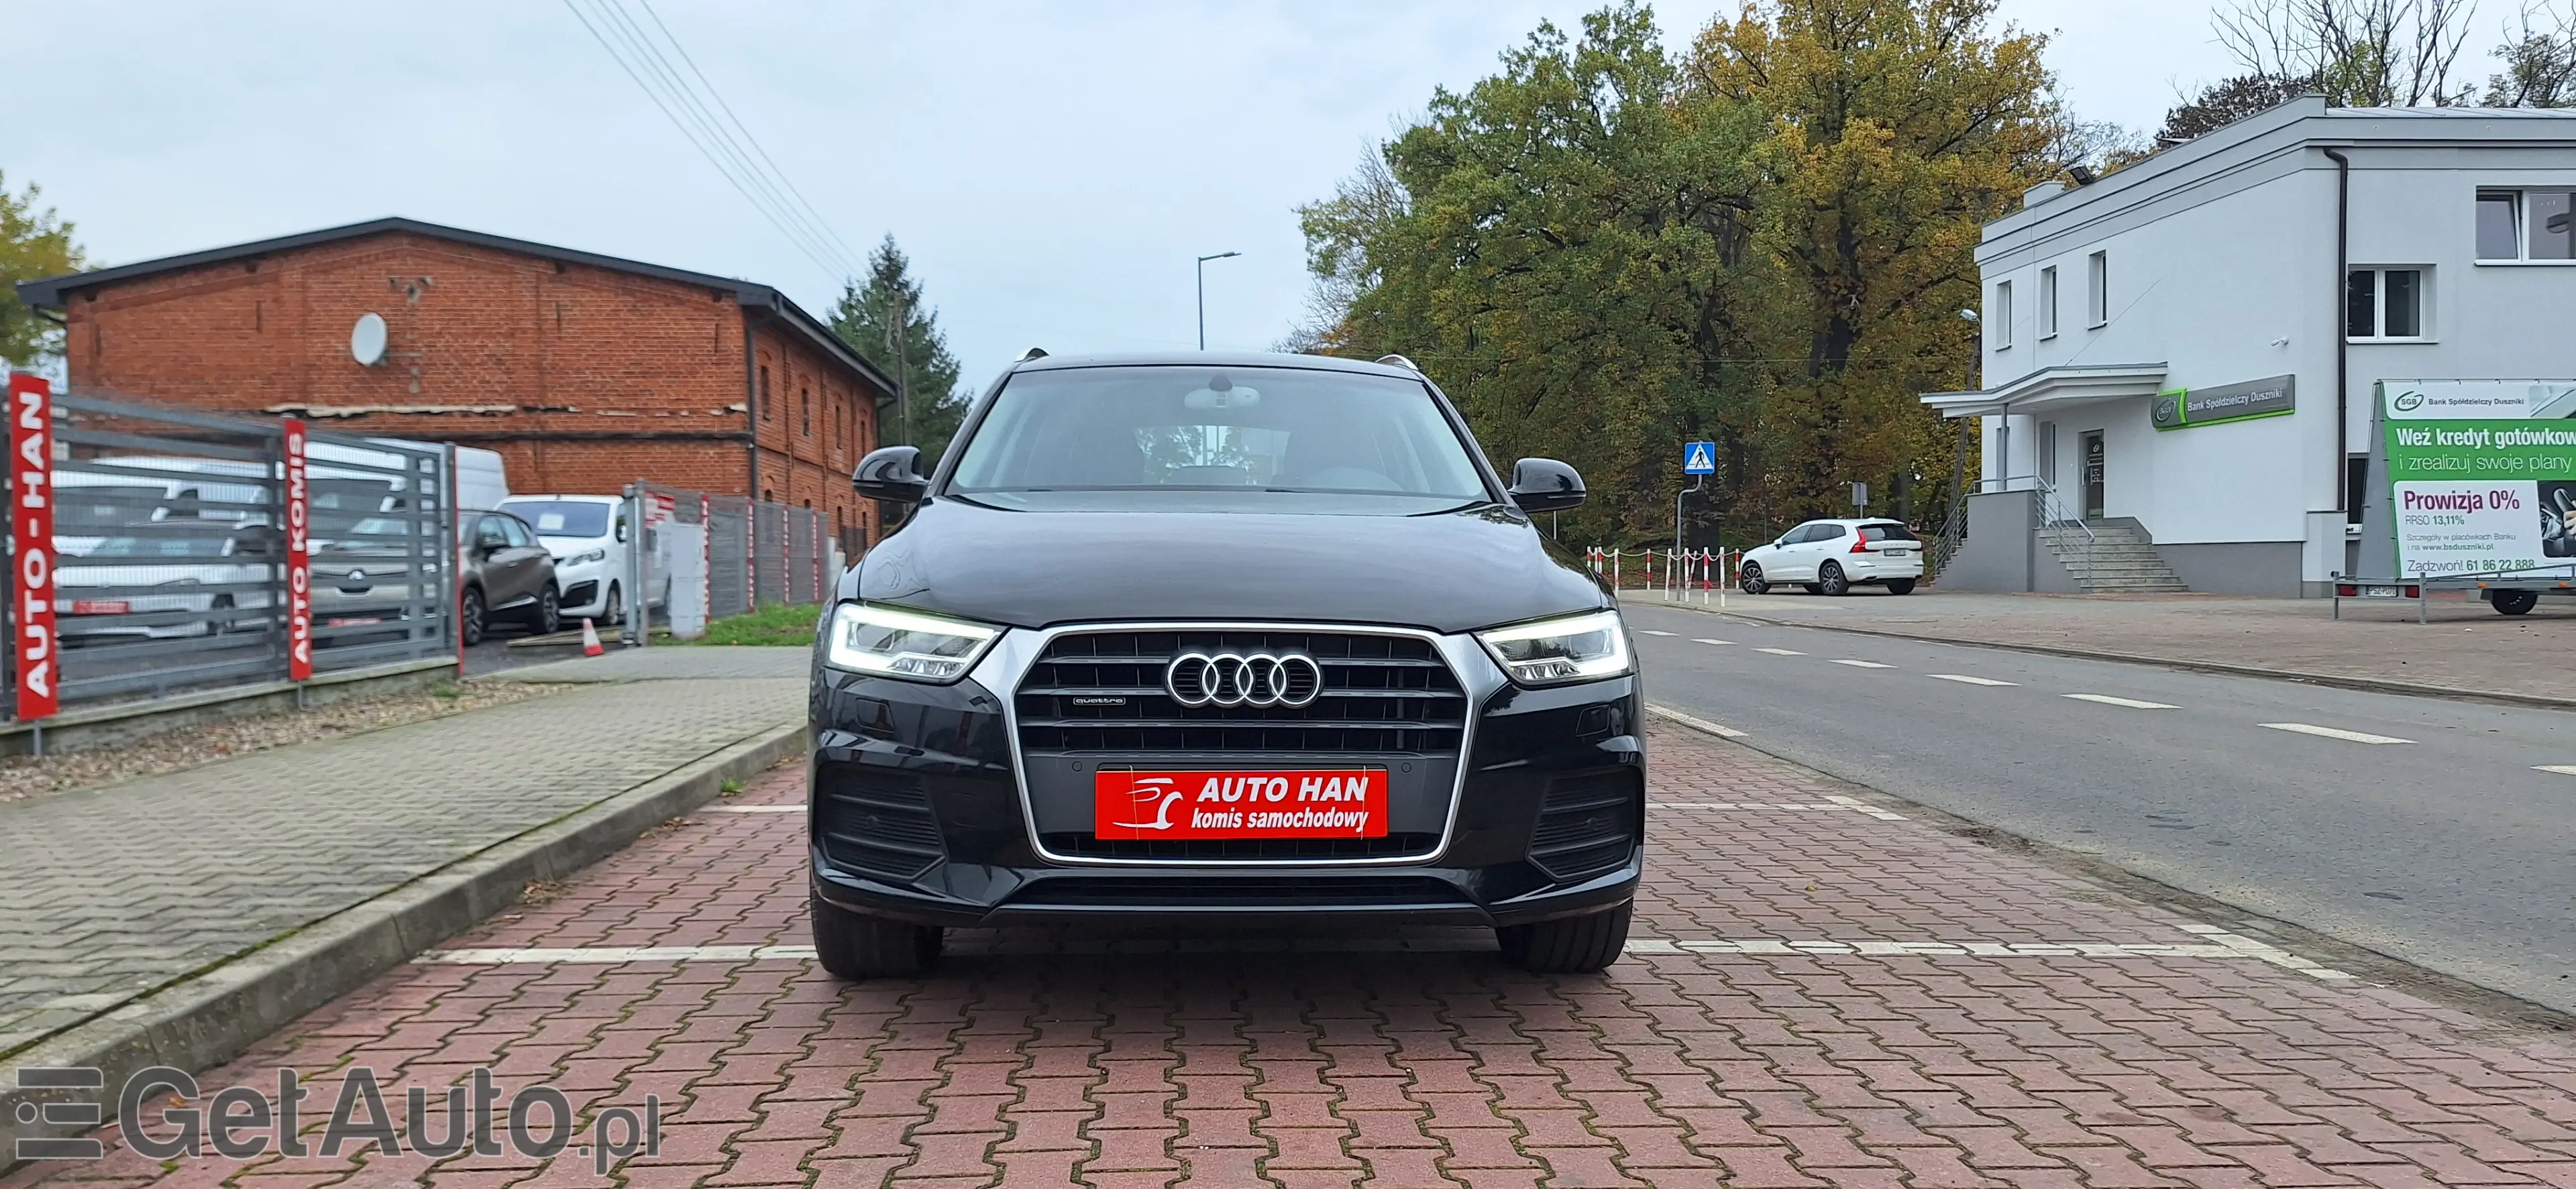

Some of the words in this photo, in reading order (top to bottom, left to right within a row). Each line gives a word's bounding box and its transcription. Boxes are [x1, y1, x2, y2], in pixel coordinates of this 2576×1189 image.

[2188, 402, 2204, 412] Bank
[2206, 394, 2249, 410] Spółdzielczy
[2251, 388, 2282, 401] Duszniki
[19, 391, 45, 509] HAN
[2396, 427, 2432, 446] Weź
[2436, 428, 2491, 449] kredyt
[2398, 454, 2403, 469] i
[2408, 454, 2471, 473] zrealizuj
[2476, 454, 2523, 473] swoje
[2529, 453, 2572, 473] plany
[289, 431, 305, 552] KOMIS
[2404, 490, 2483, 514] Prowizja
[2489, 490, 2520, 510] 0%
[2405, 516, 2430, 525] RRSO
[2433, 515, 2465, 526] 13,11%
[2407, 559, 2463, 571] Zadzwoń!
[2467, 559, 2478, 571] 61
[2482, 559, 2496, 570] 86
[2498, 559, 2512, 570] 22
[2515, 559, 2535, 569] 888
[23, 547, 51, 699] AUTO
[292, 566, 309, 665] AUTO
[1197, 777, 1289, 802] AUTO
[1297, 777, 1369, 801] HAN
[1191, 807, 1243, 828] komis
[1246, 807, 1370, 833] samochodowy
